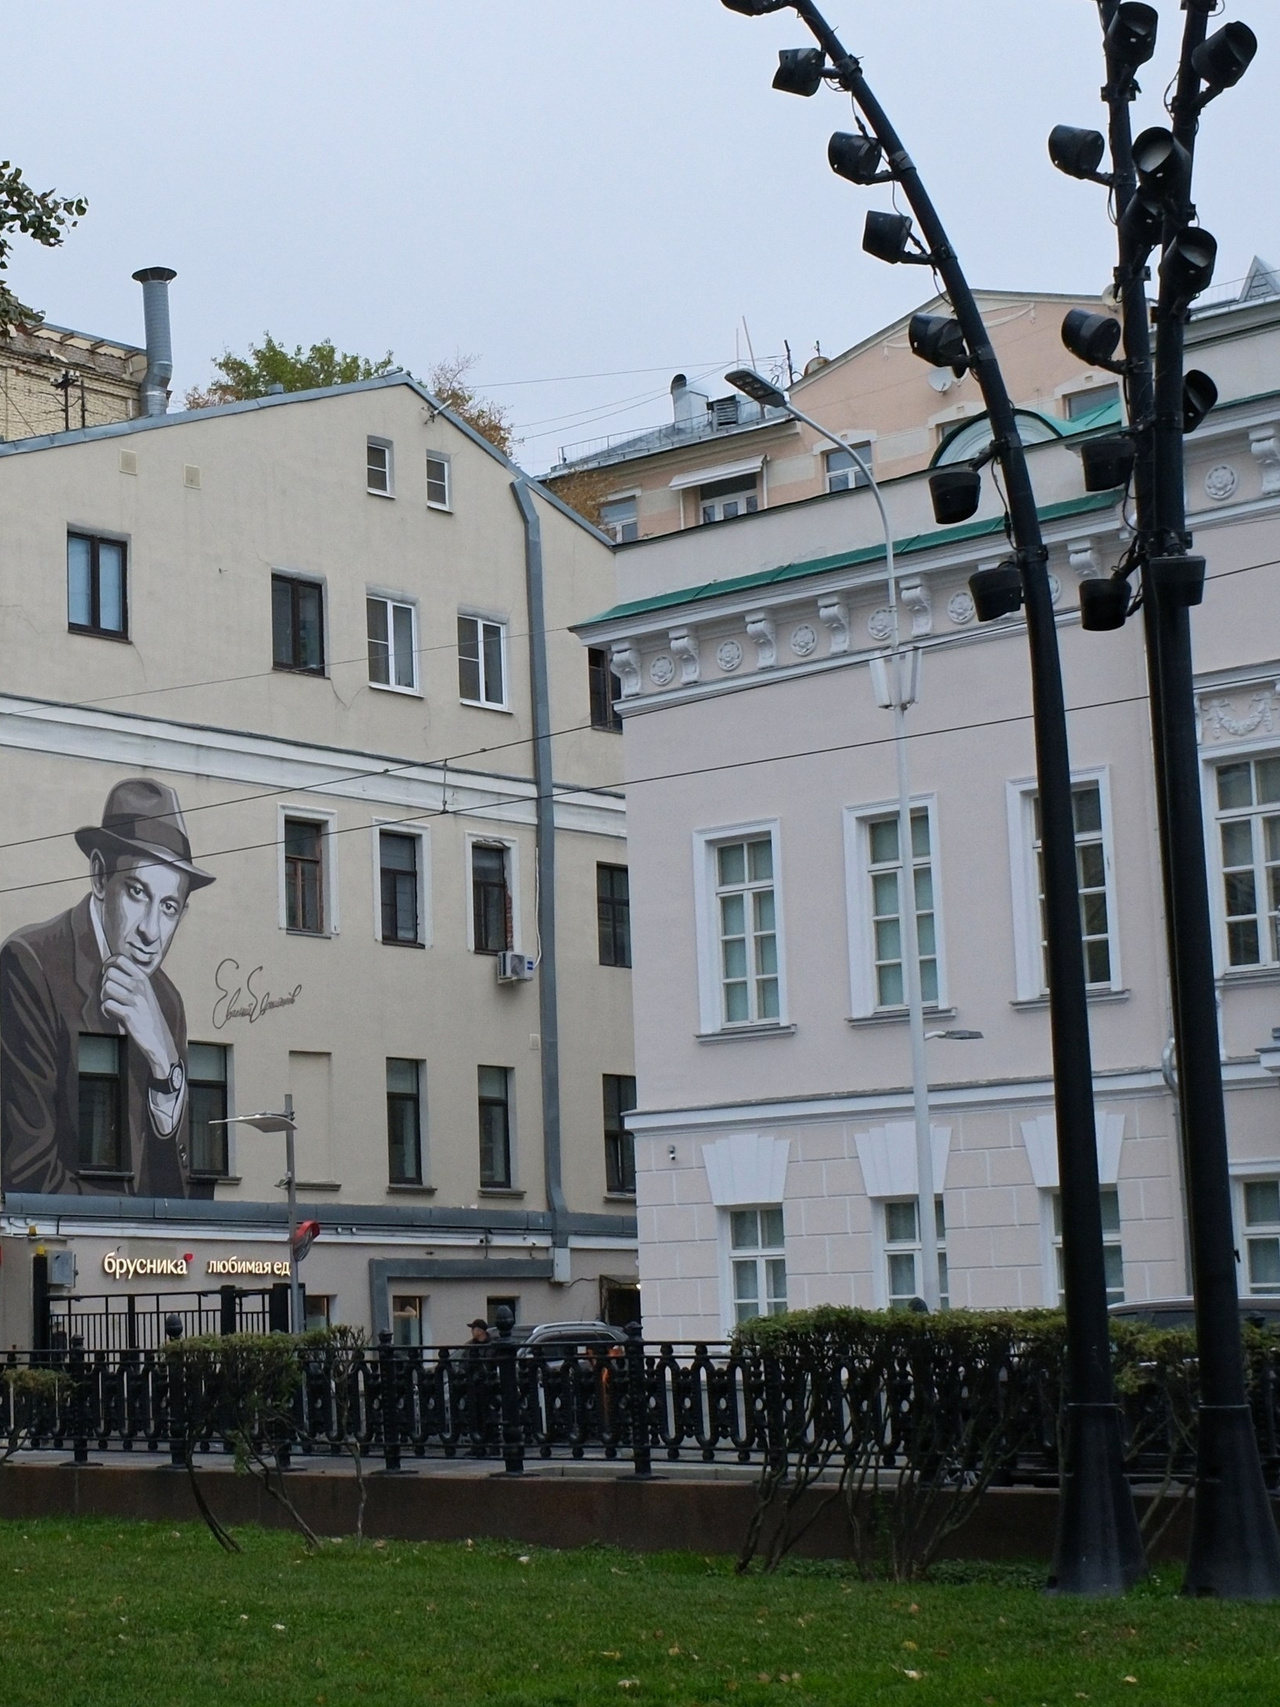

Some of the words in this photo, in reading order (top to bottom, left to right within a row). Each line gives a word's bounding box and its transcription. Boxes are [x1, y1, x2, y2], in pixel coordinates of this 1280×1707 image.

[103, 1252, 187, 1279] брусника
[208, 1256, 271, 1274] любимая
[273, 1262, 291, 1276] ед
